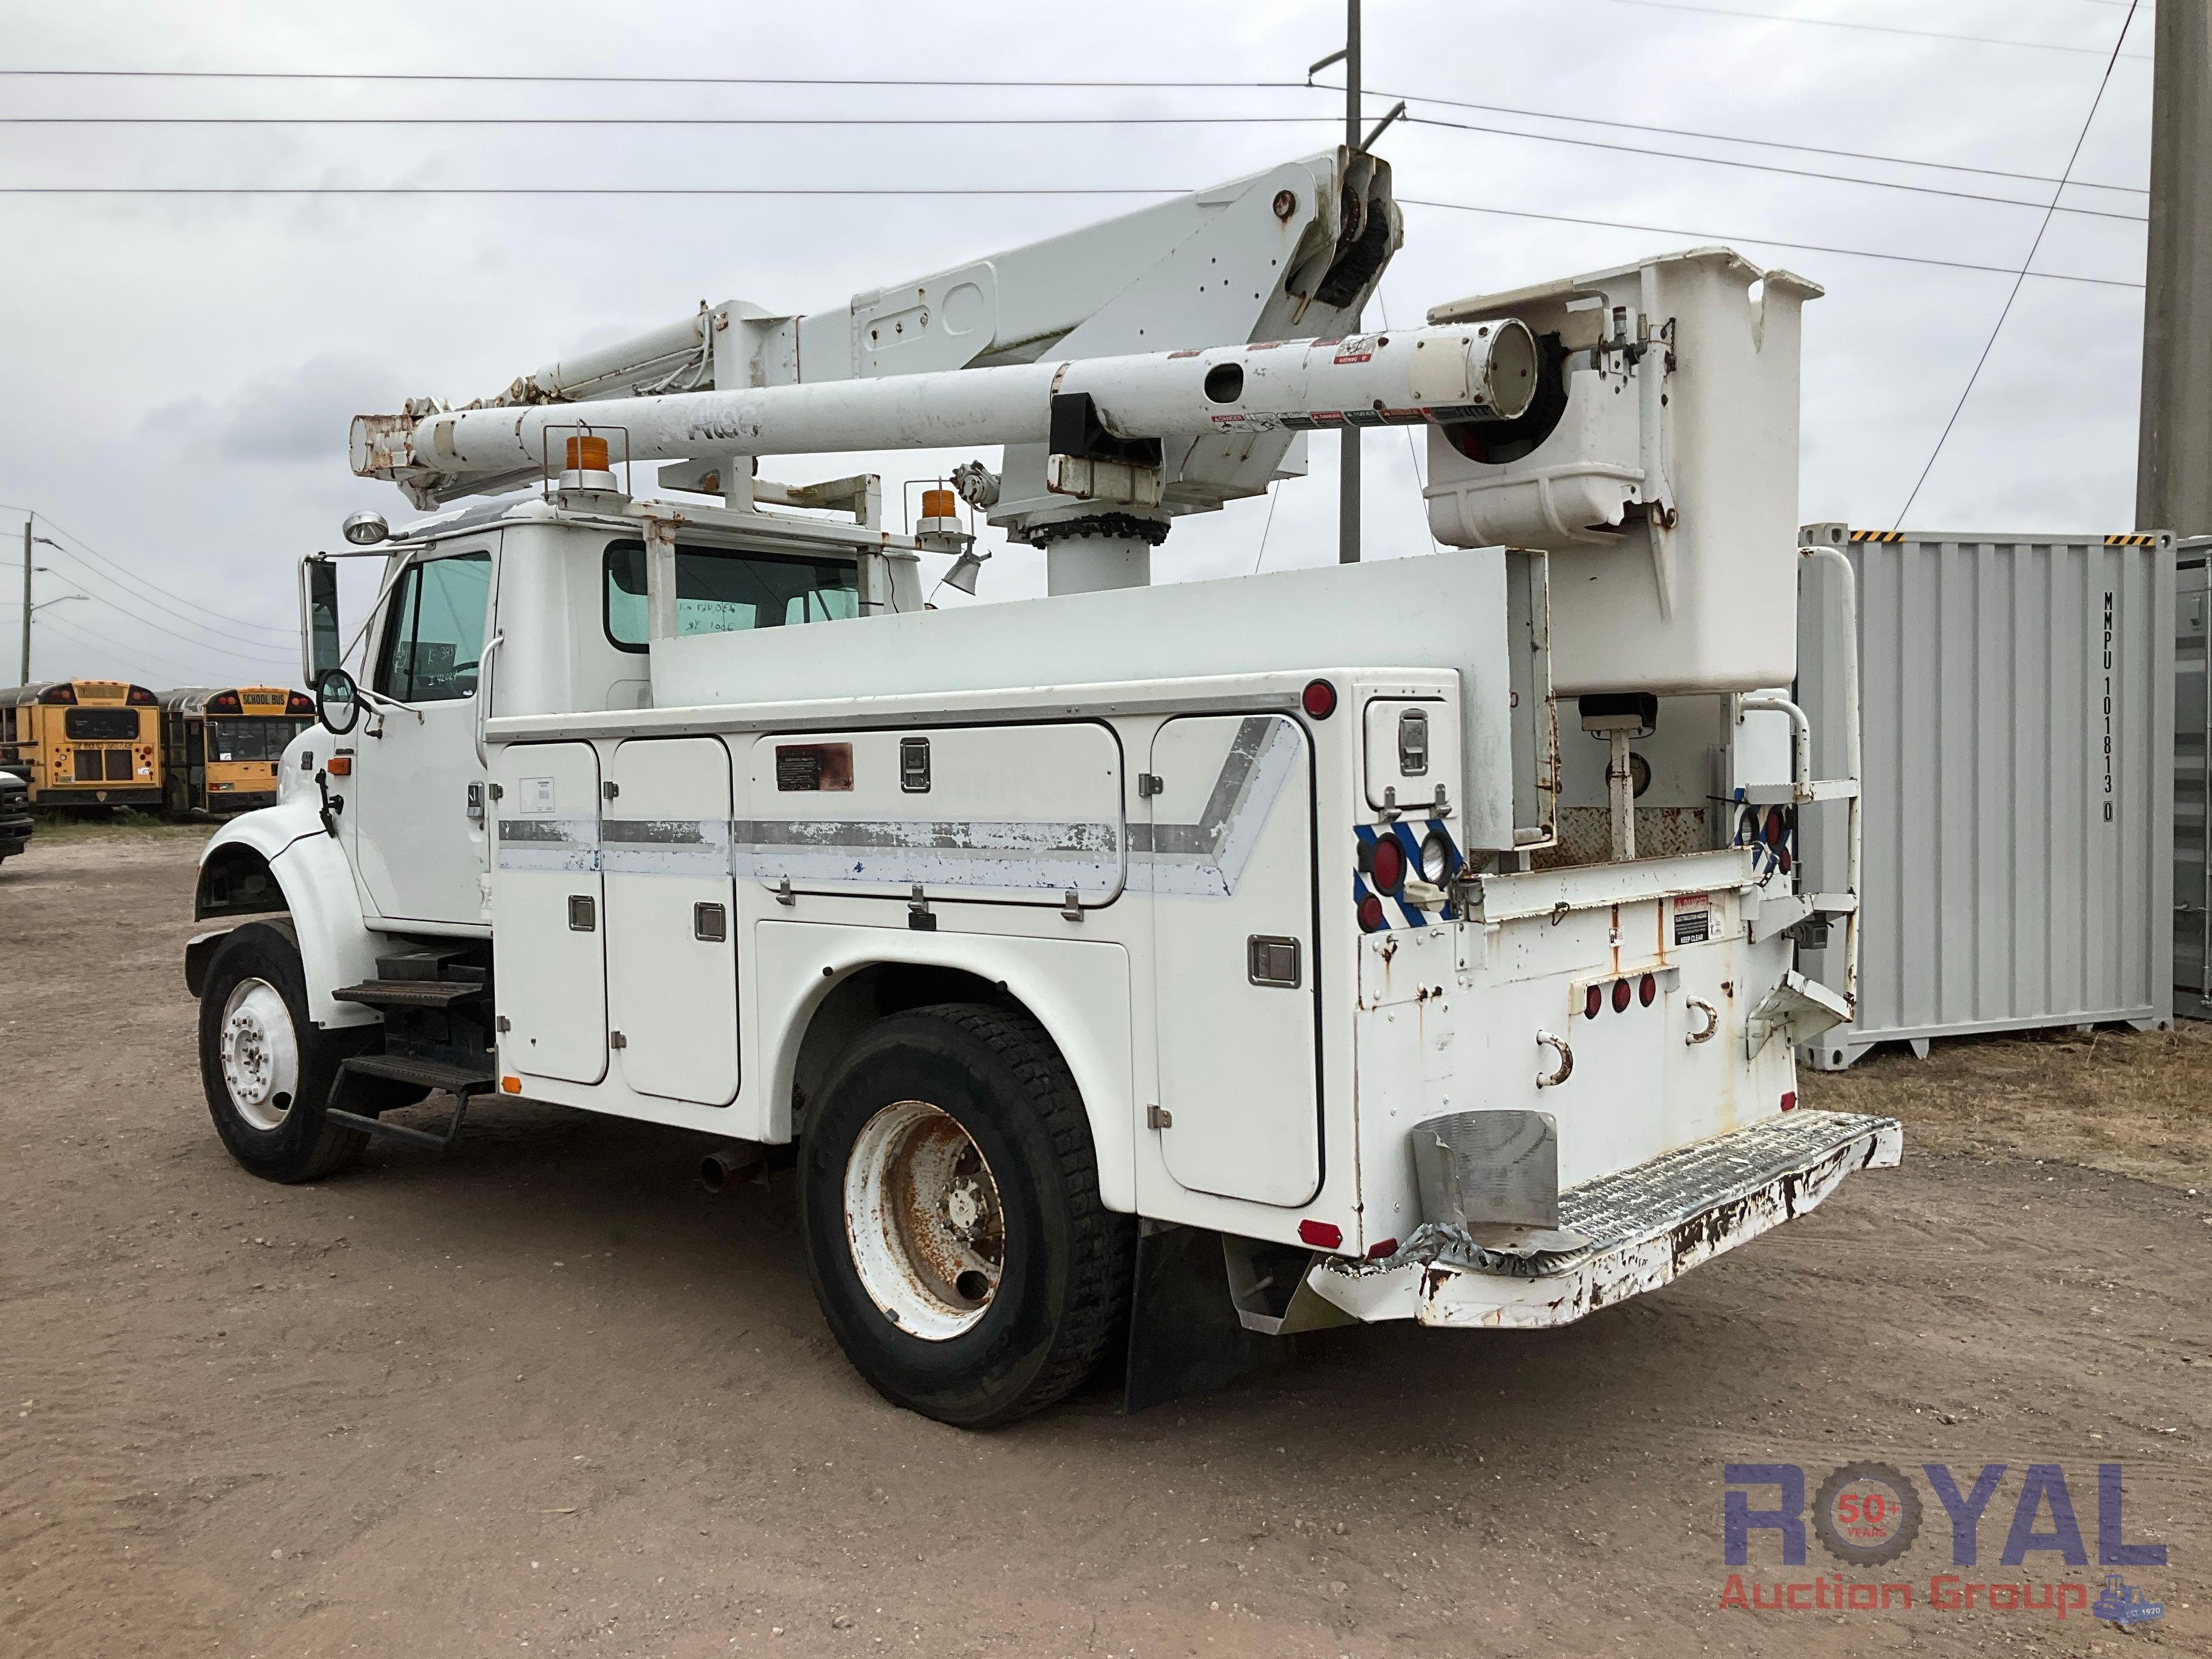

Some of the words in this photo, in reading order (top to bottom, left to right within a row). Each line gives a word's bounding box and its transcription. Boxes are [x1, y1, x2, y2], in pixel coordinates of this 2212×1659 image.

[2104, 592, 2113, 670] MMPU
[243, 694, 270, 705] SCHOOL
[271, 694, 285, 705] BUS
[2104, 676, 2112, 793] 101813
[2104, 801, 2112, 821] 0
[1680, 935, 1691, 944] KEEP
[1691, 934, 1703, 942] CLEAR
